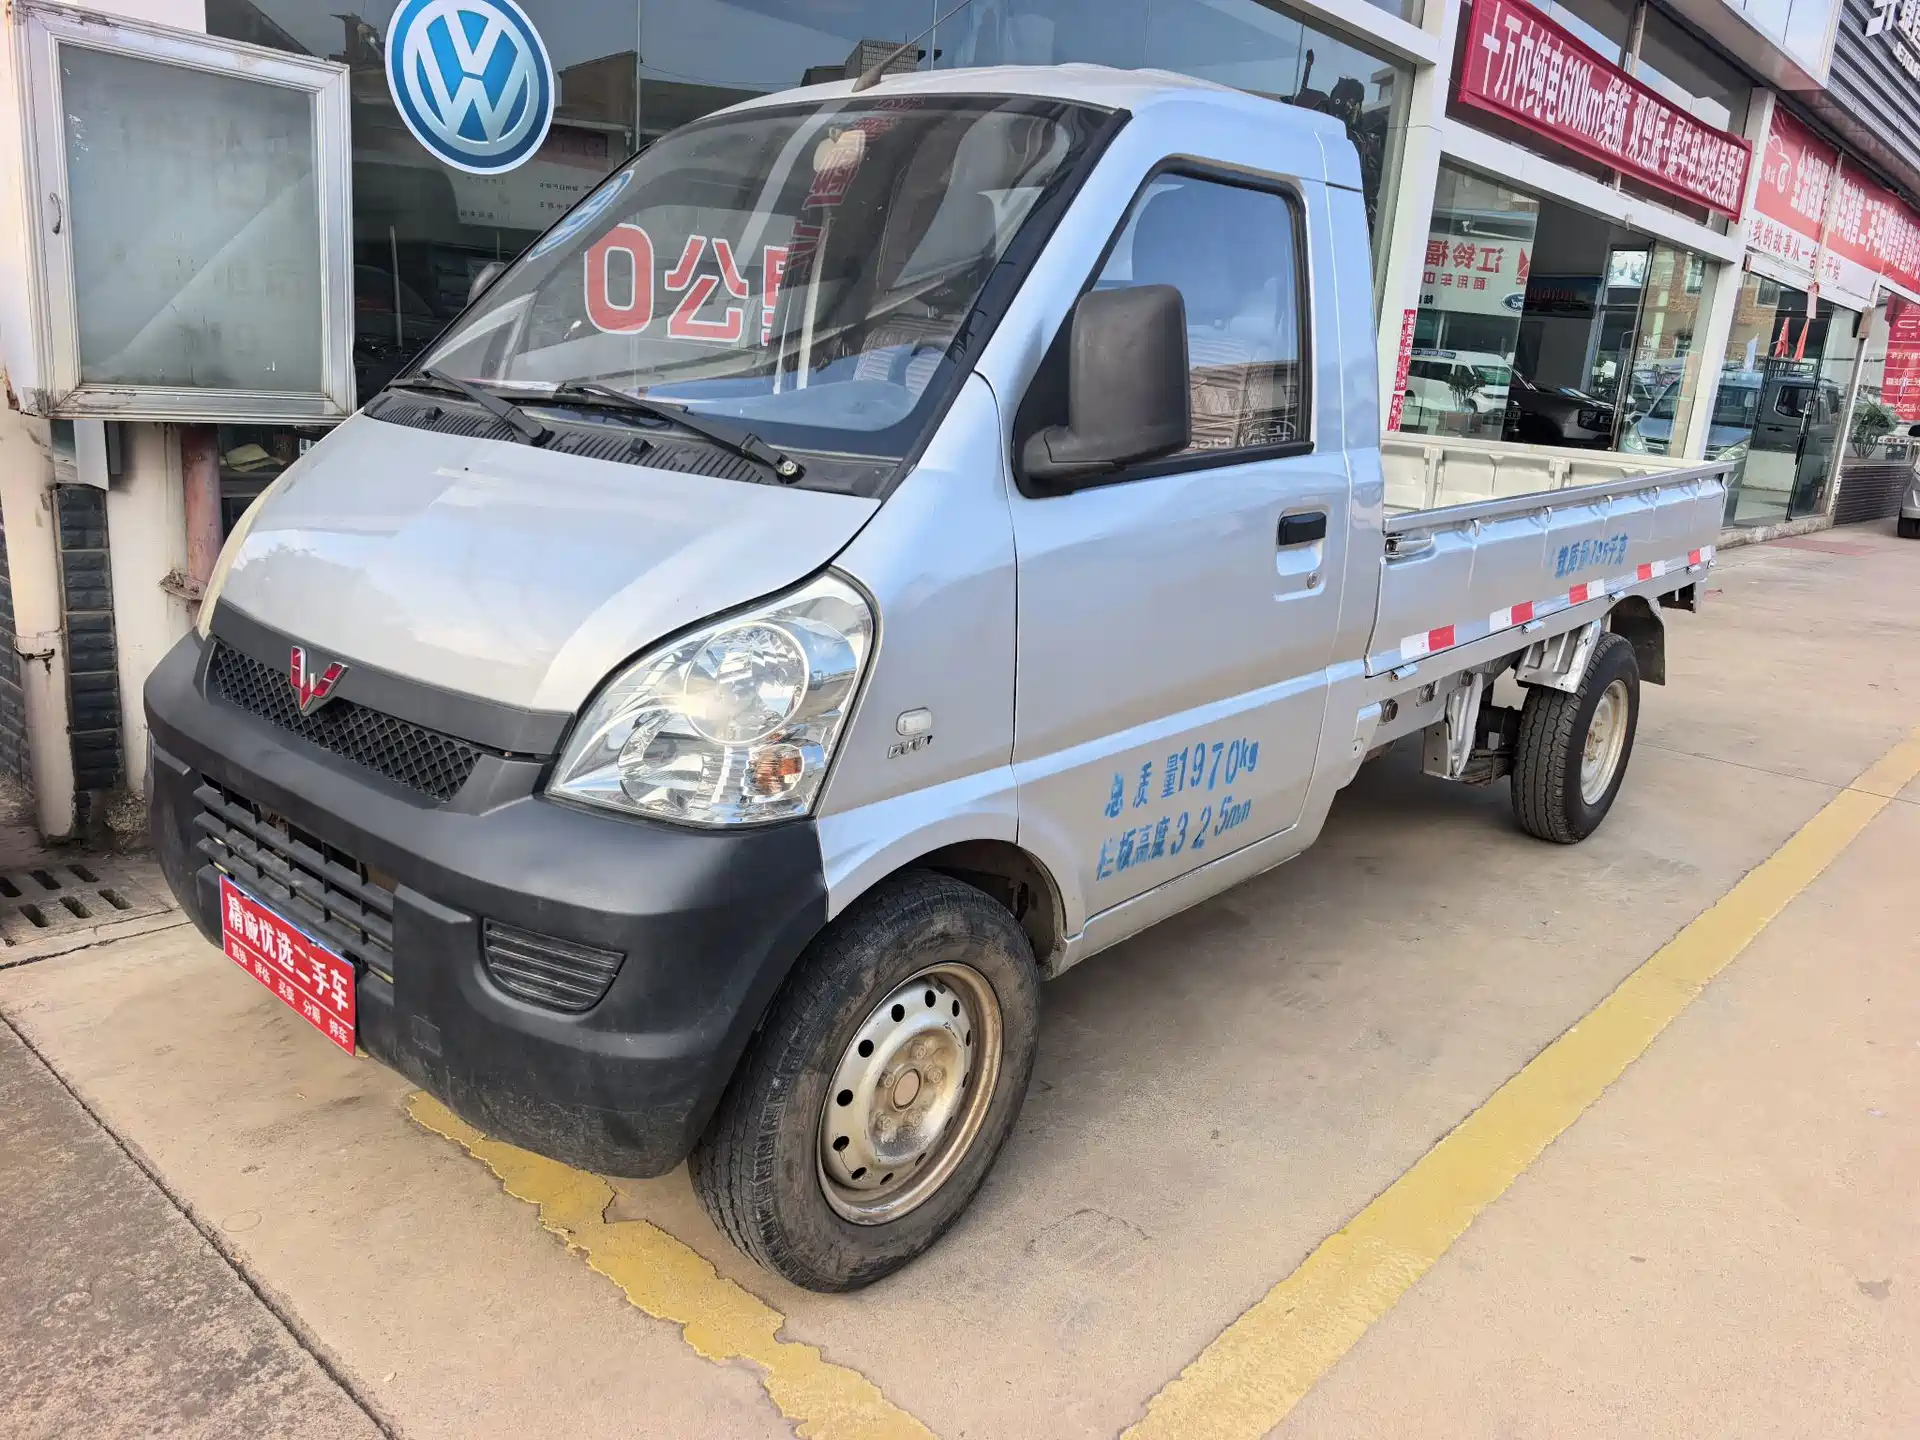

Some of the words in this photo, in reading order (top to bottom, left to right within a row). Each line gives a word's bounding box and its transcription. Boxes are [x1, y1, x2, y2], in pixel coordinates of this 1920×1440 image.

[226, 892, 349, 1012] 精诚优选二手车
